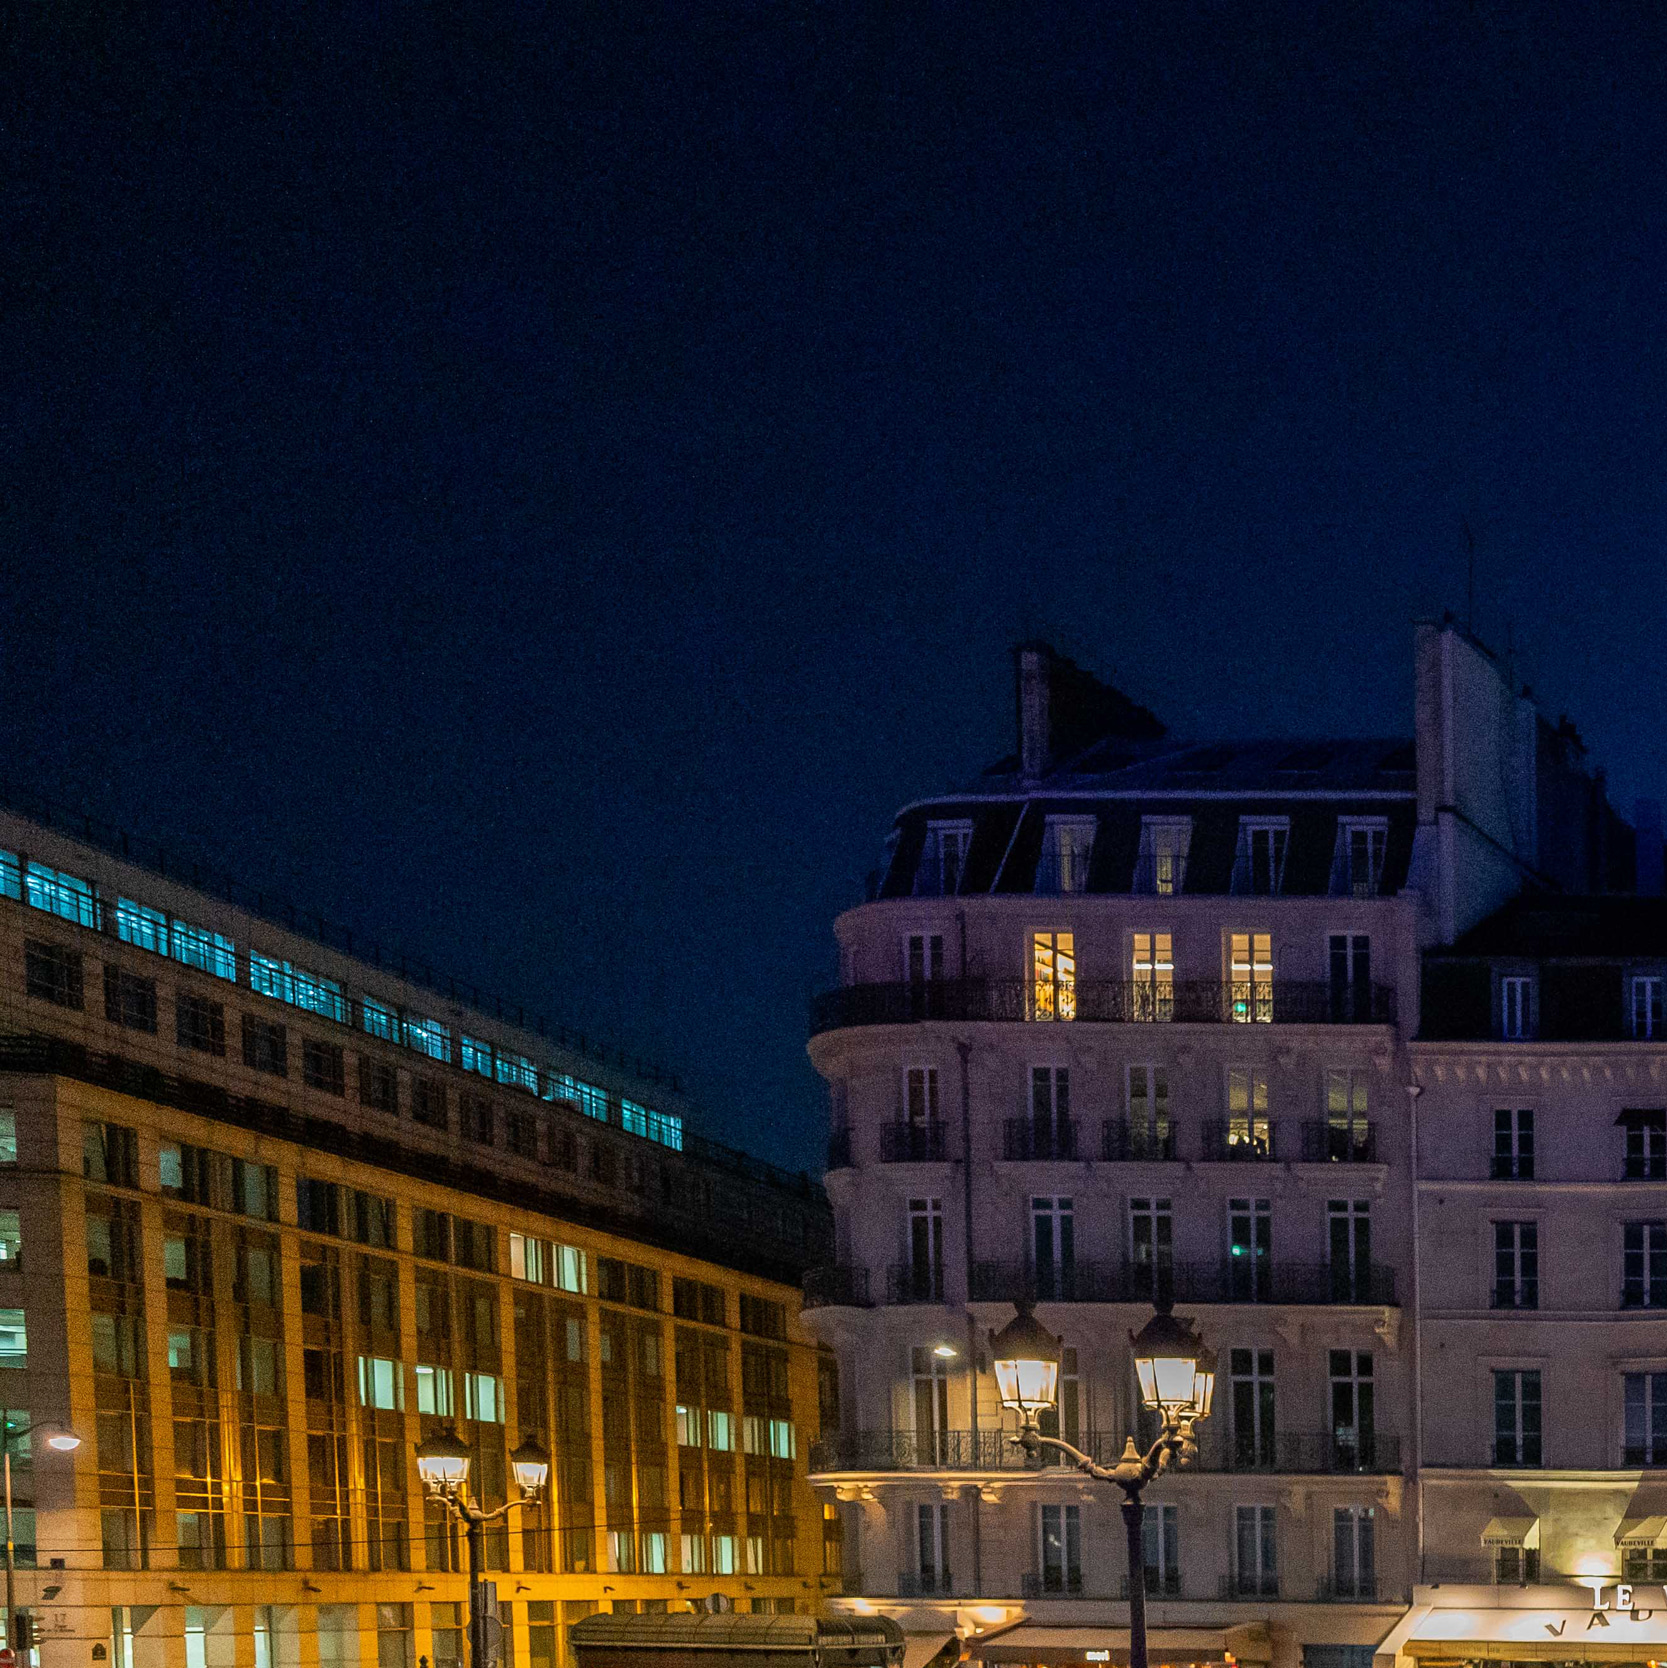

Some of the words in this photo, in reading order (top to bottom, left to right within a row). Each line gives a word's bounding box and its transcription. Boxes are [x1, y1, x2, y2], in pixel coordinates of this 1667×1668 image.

[1484, 1538, 1523, 1546] VAUDEVILLE
[1616, 1539, 1655, 1547] VAUDEVILLE
[1592, 1585, 1634, 1611] LE
